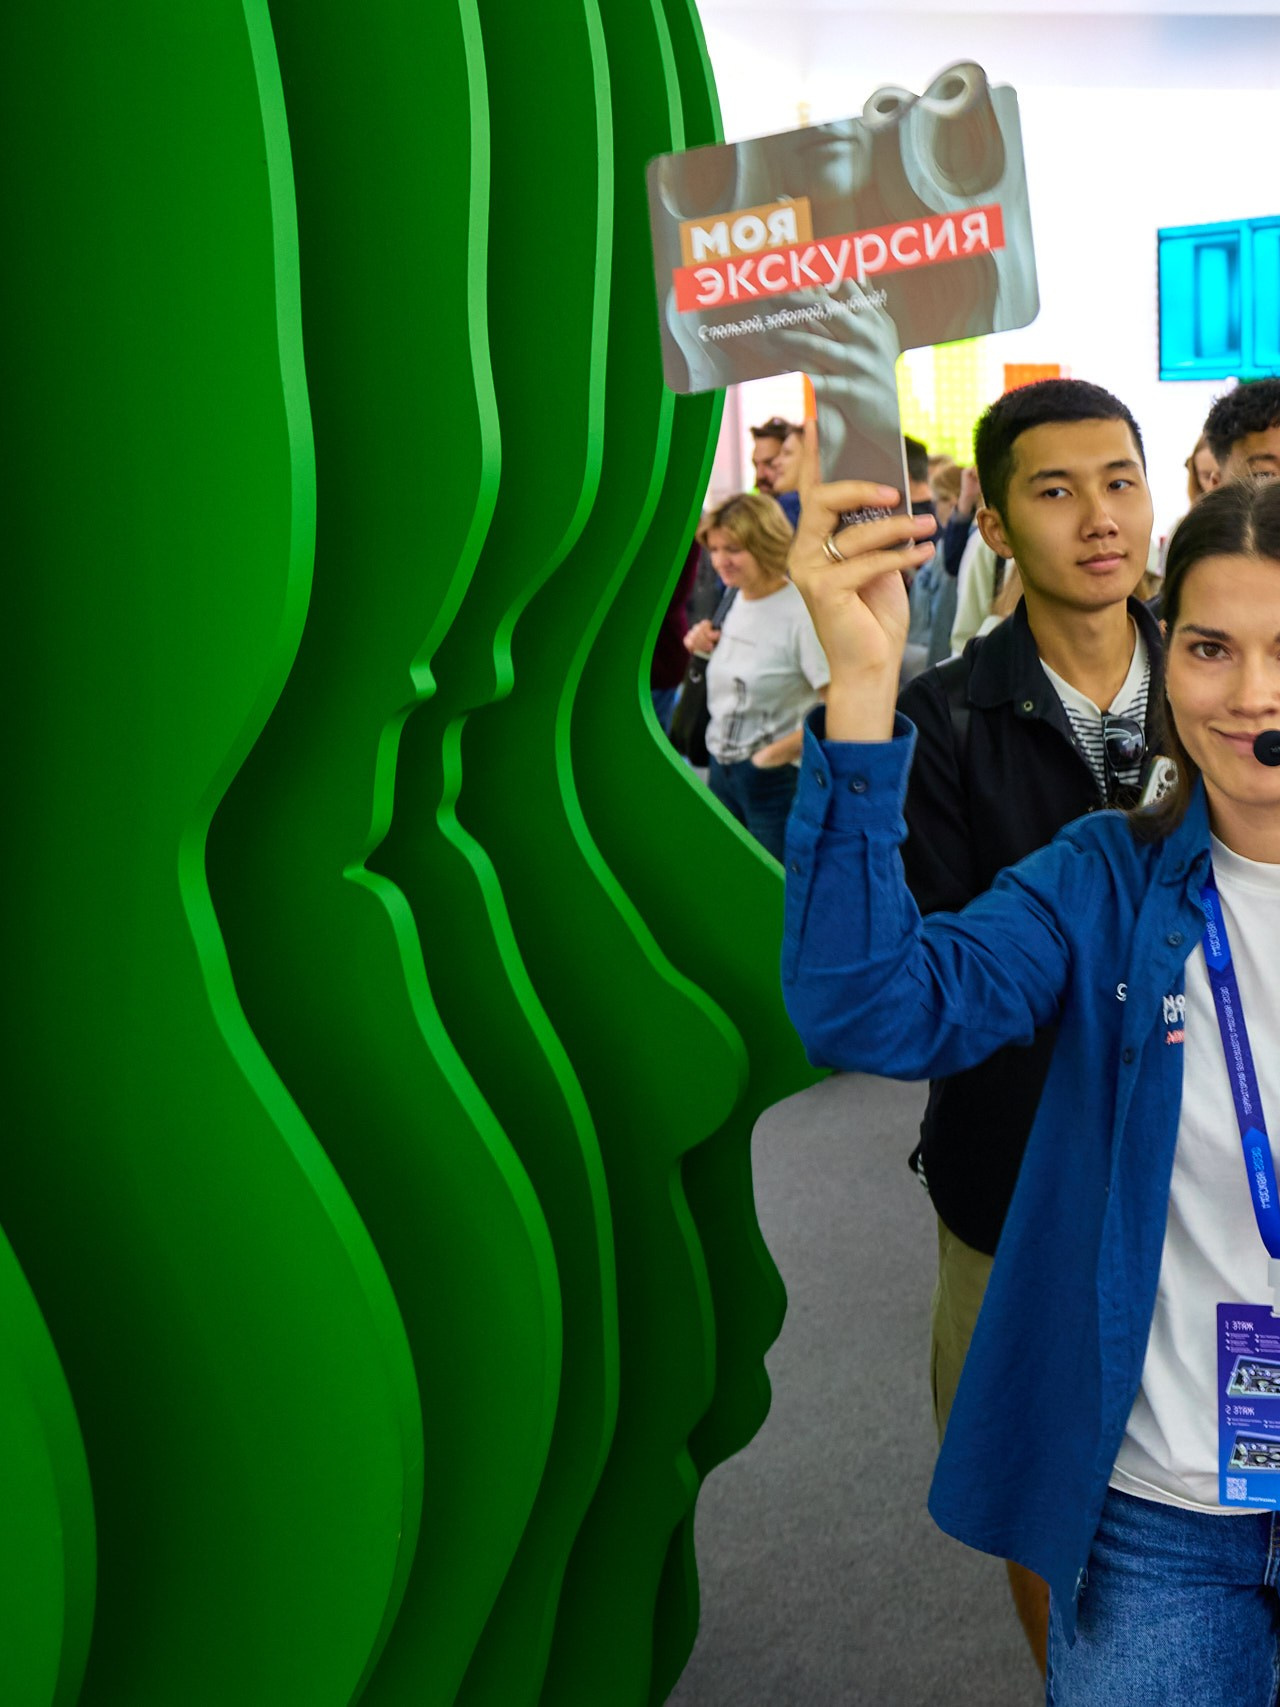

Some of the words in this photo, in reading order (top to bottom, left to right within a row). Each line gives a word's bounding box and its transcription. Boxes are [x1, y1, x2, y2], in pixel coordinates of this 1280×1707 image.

[690, 207, 798, 262] МОЯ
[693, 211, 990, 305] ЭКСКУРСИЯ
[1232, 1320, 1254, 1331] ЭТАЖ
[1225, 1404, 1231, 1415] 2
[1233, 1405, 1255, 1416] ЭТАЖ
